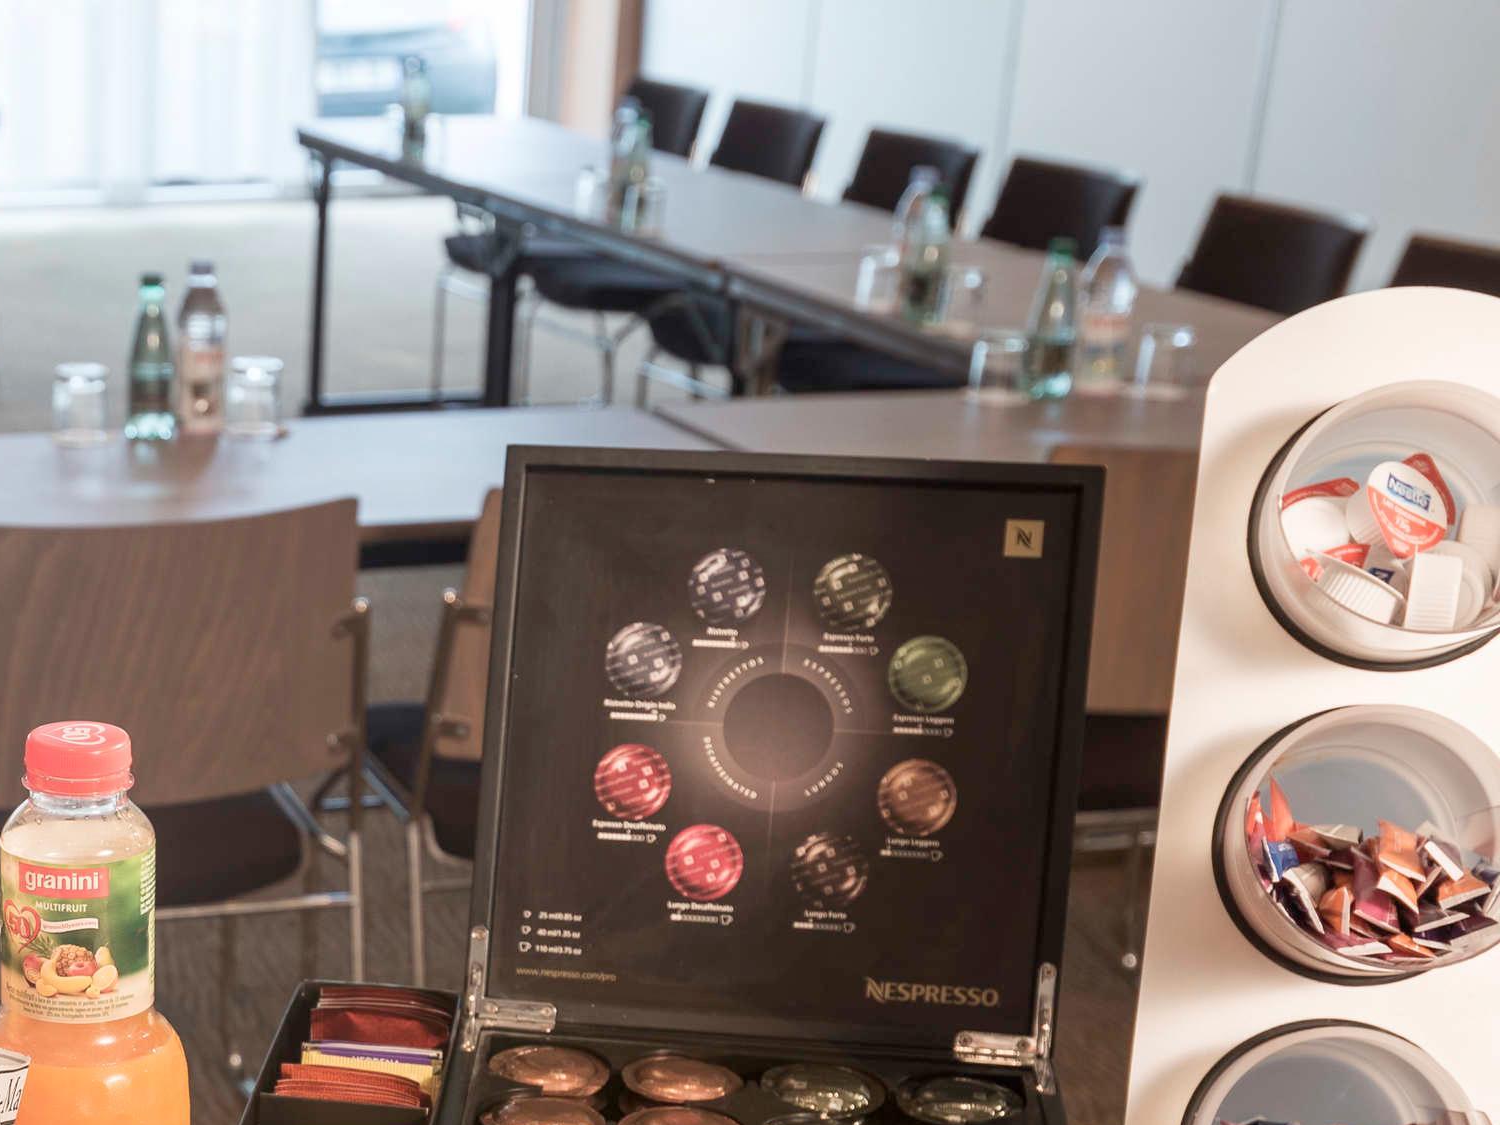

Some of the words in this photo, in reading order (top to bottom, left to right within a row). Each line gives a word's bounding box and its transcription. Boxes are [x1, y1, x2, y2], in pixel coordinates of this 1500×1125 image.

[592, 818, 623, 831] Espresso
[25, 870, 99, 891] granini
[35, 900, 88, 913] MULTIFRUIT
[864, 976, 1000, 1007] NESPRESSO
